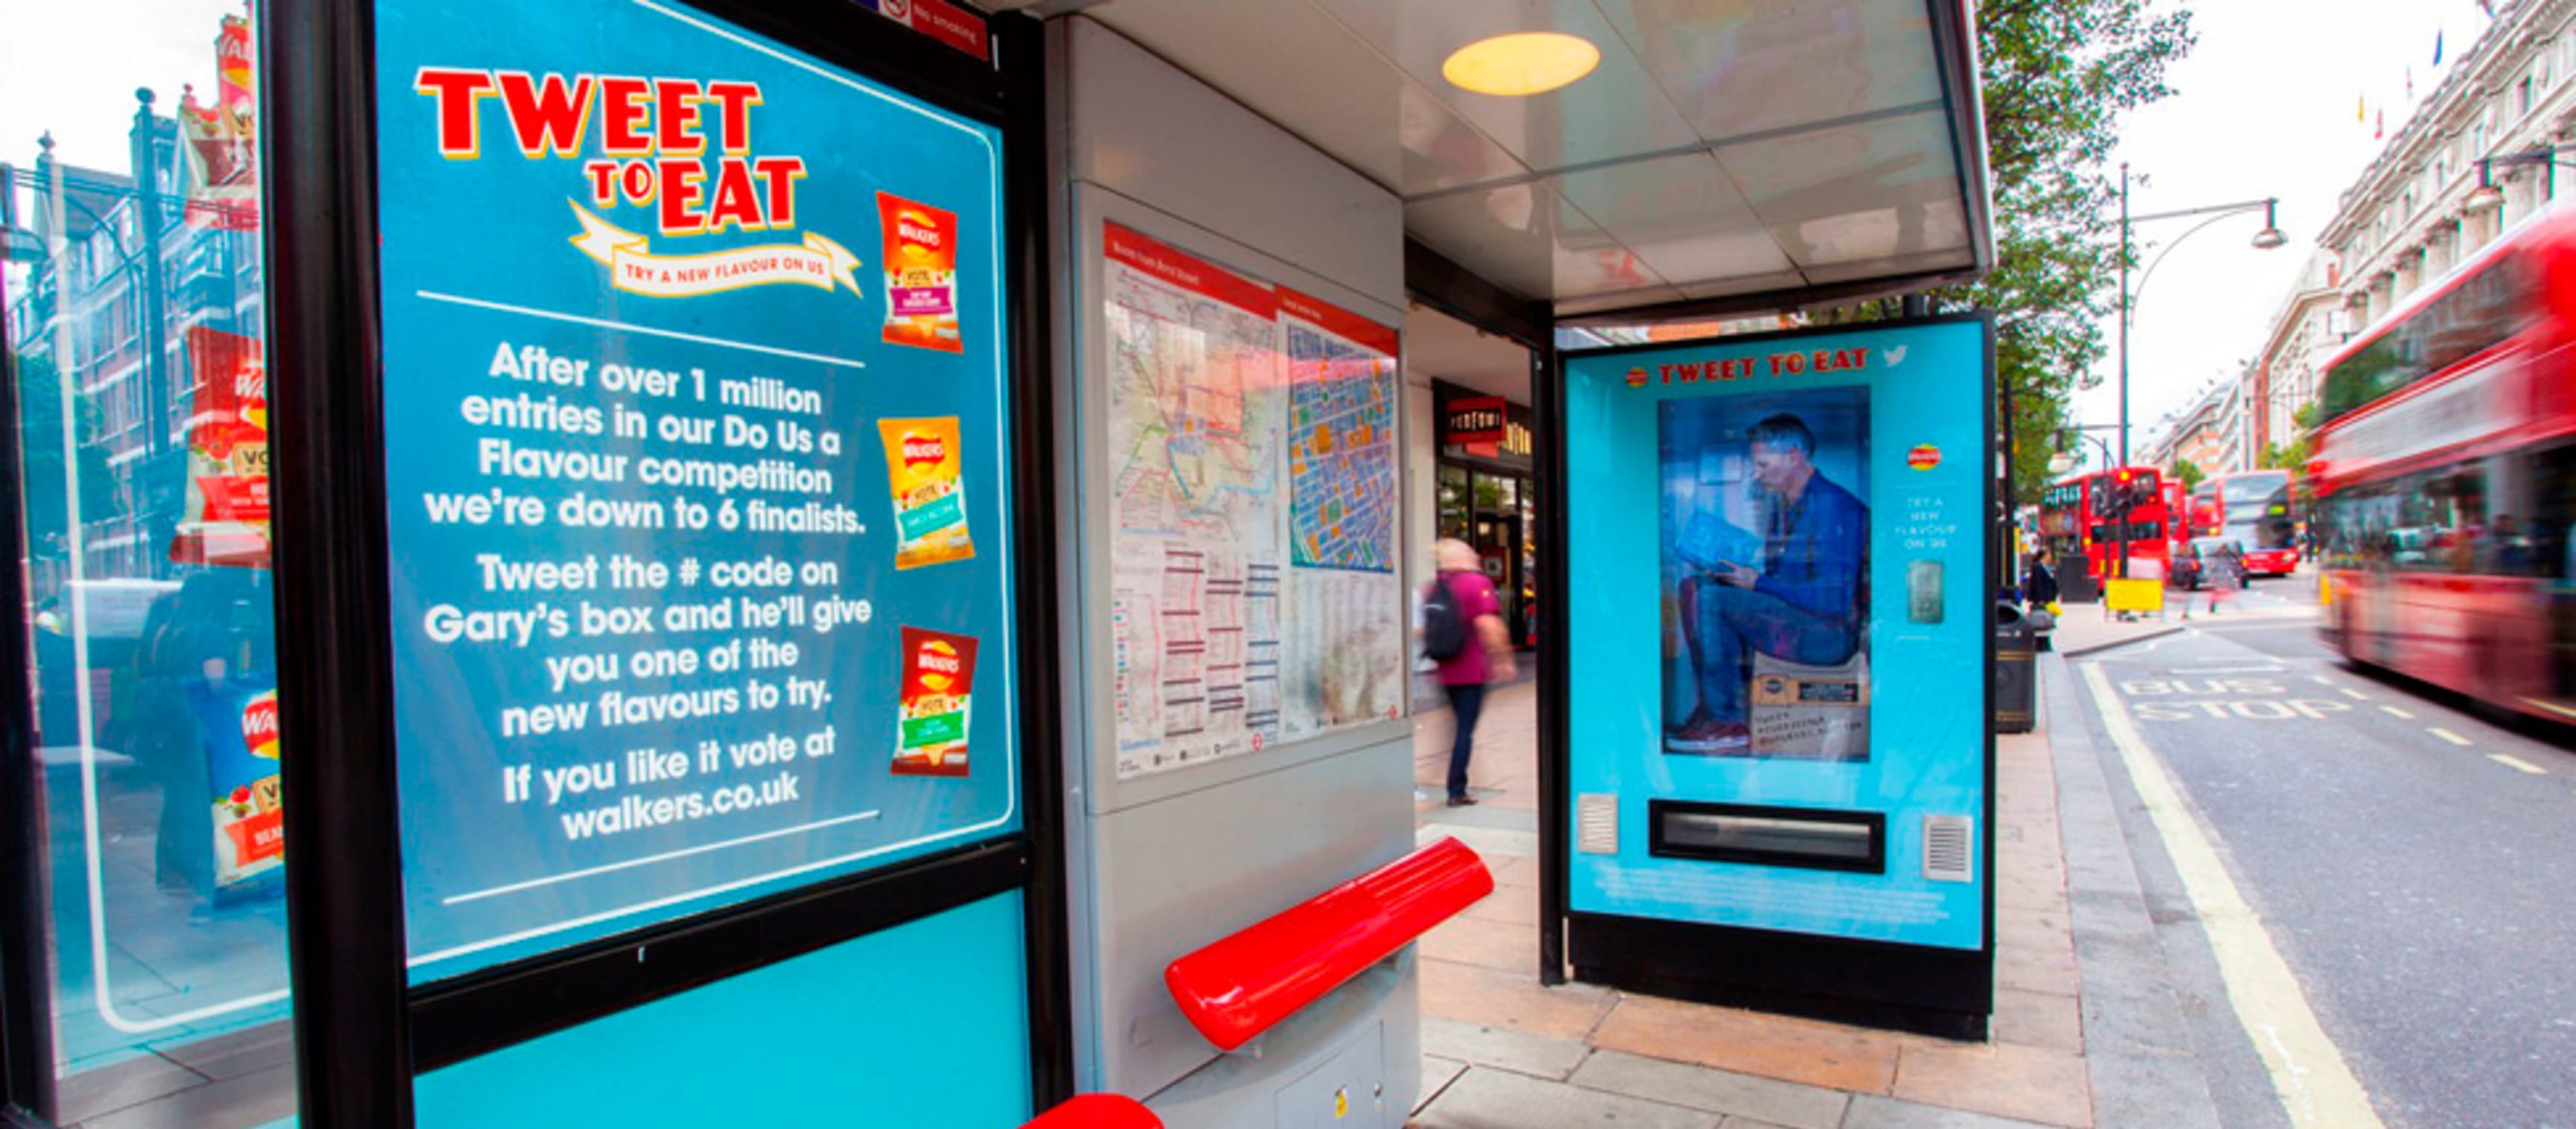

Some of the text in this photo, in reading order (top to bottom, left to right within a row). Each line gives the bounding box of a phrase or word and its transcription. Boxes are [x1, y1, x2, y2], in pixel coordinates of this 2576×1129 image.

[415, 67, 763, 159] TWEET
[584, 156, 809, 235] TO EAT
[625, 258, 824, 283] TRY A NEW FLAVOUR ON US
[490, 343, 820, 413] After over 1 million
[1659, 348, 1869, 384] TWEET TO EAT
[462, 392, 840, 454] entries in our Do Us a
[479, 438, 832, 495] Flavour competition
[424, 488, 864, 532] we're down to 6 finalists.
[476, 554, 838, 590] Tweet the # code on
[424, 595, 871, 646] Gary's box and he'll give
[546, 637, 799, 692] you one of the
[2121, 678, 2288, 696] BUS
[503, 676, 831, 737] new flavours to try.
[2132, 699, 2353, 721] STOP
[503, 725, 835, 804] If you like it vote at
[561, 771, 798, 840] walkers.co.uk
